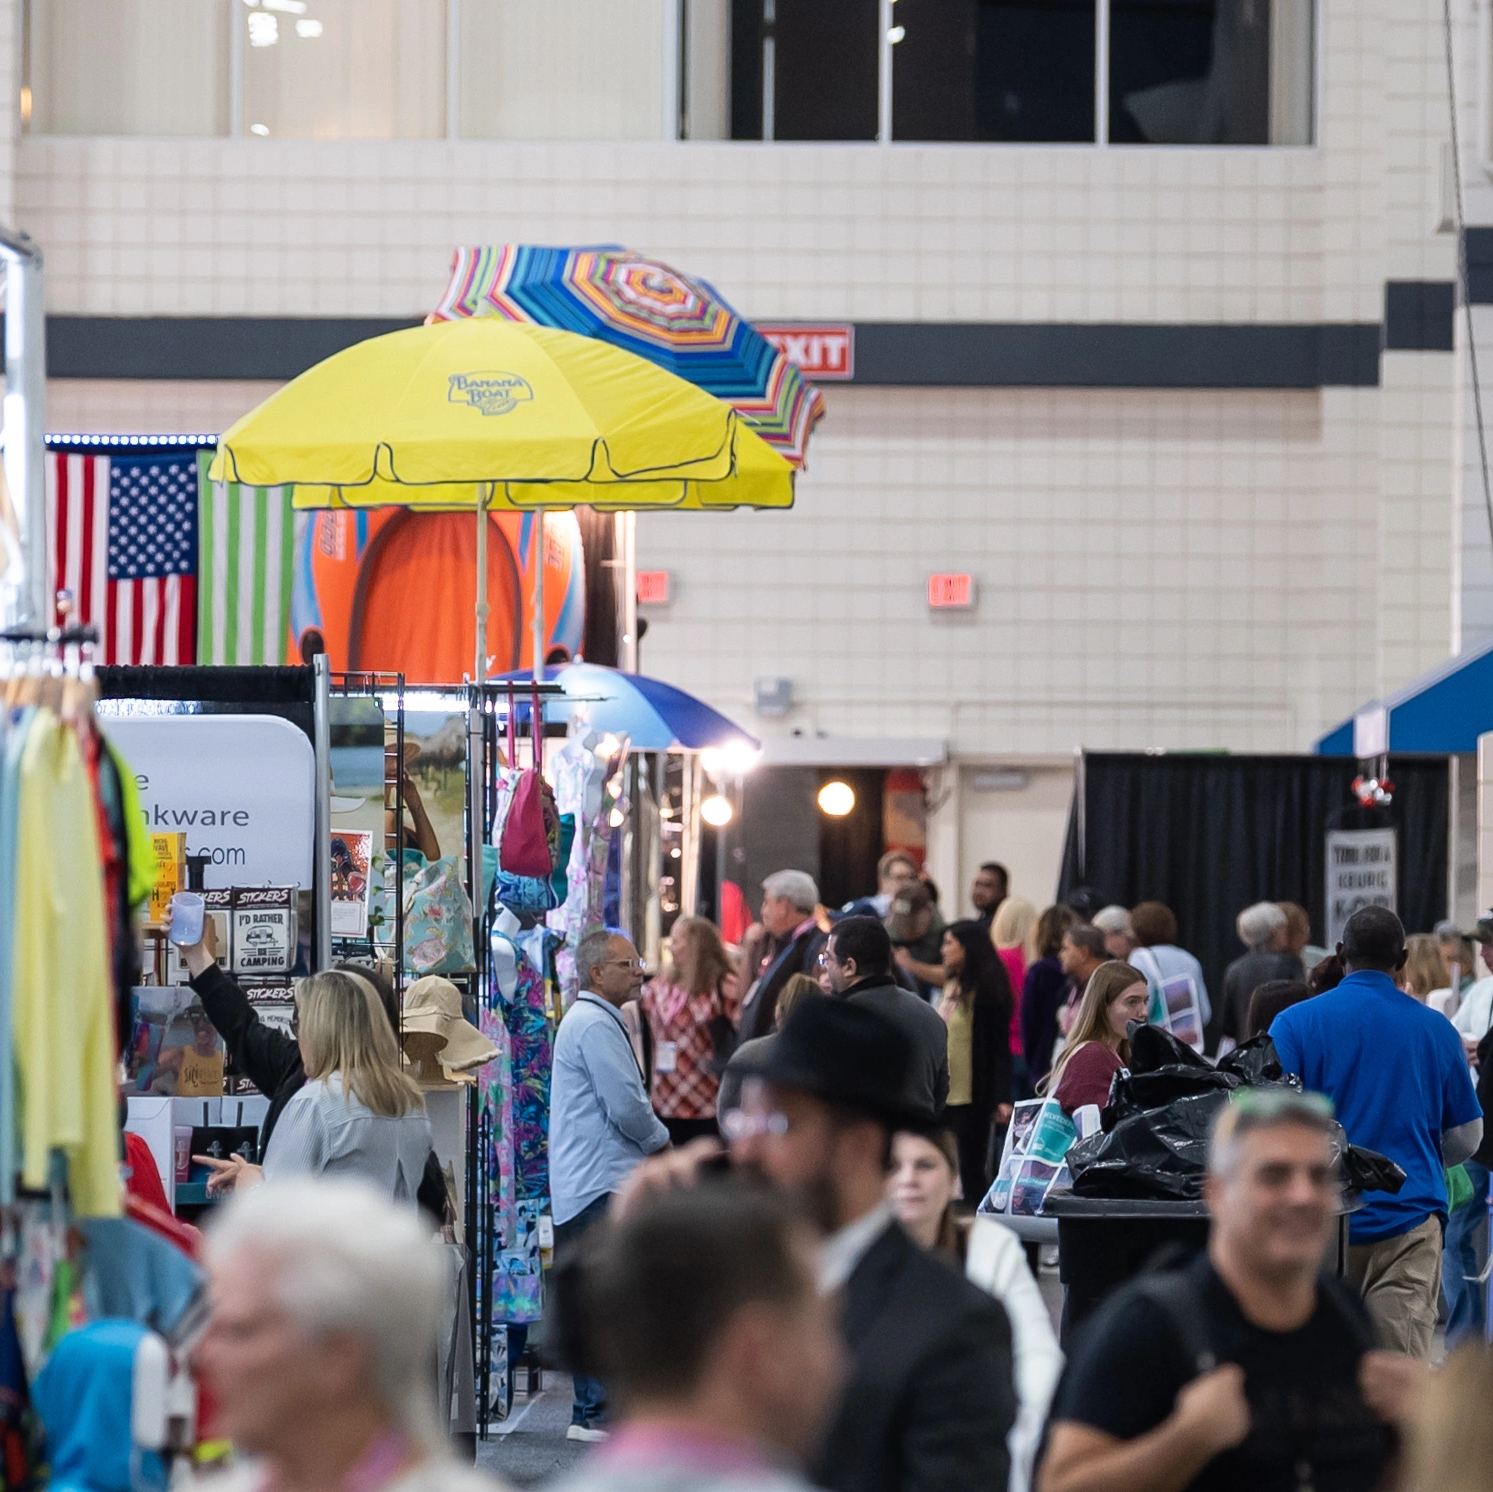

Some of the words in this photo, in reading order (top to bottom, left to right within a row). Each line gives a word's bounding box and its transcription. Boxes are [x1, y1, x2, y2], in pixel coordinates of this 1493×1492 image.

[448, 375, 523, 390] BANANA
[467, 389, 511, 403] BOAT
[237, 889, 289, 904] STICKERS
[253, 913, 284, 925] RATHER
[240, 957, 285, 968] CAMPING
[246, 987, 294, 1000] STICKERS
